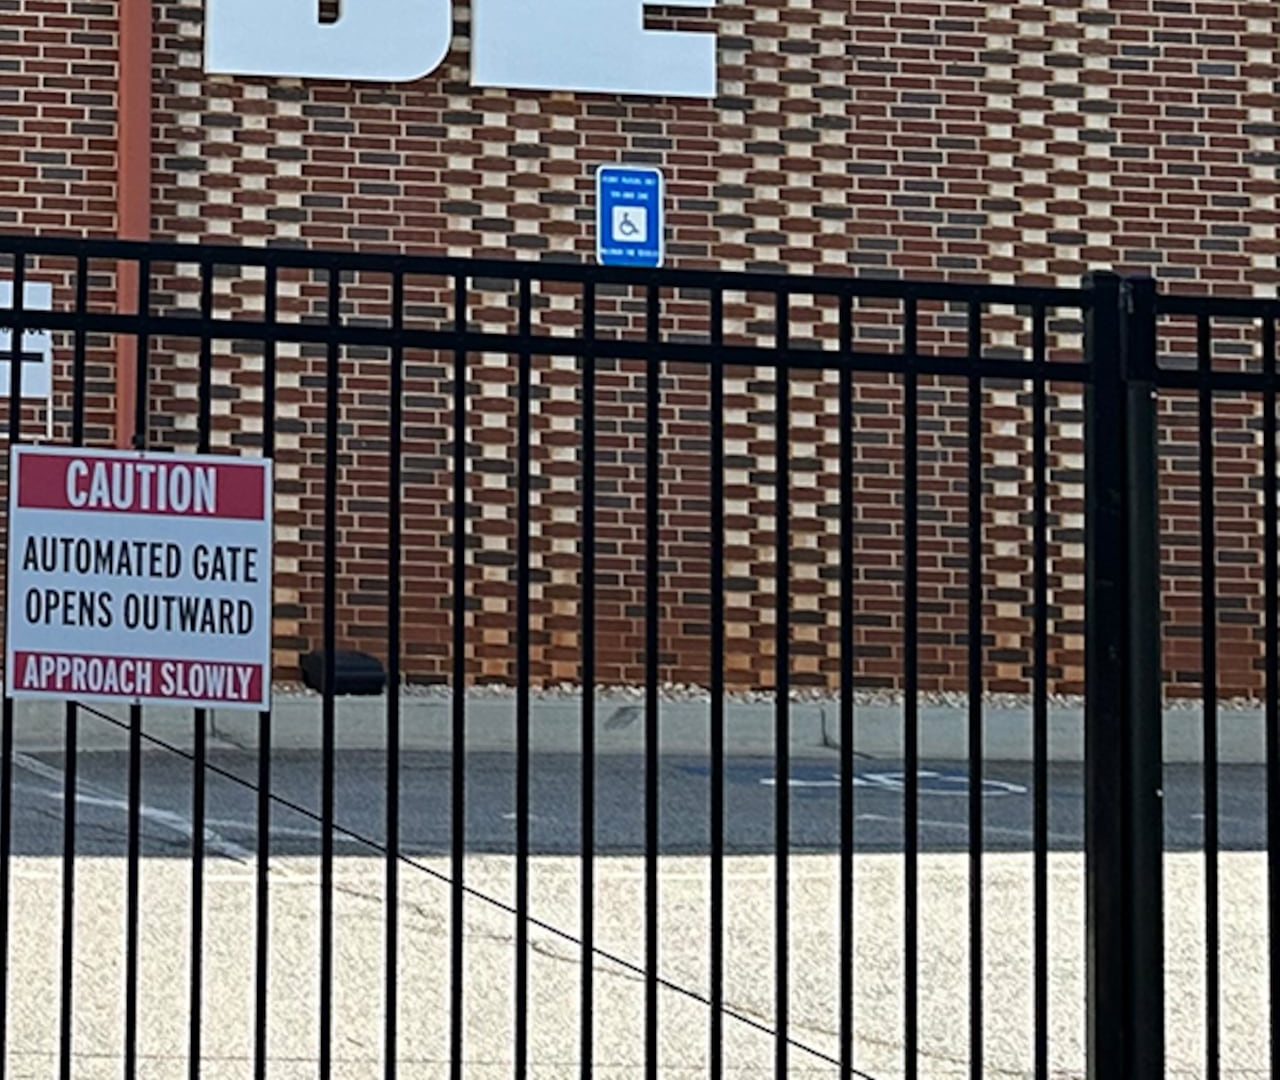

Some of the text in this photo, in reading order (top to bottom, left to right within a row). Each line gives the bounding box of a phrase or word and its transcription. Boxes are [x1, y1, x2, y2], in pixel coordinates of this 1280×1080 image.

[66, 459, 217, 513] CAUTION
[23, 536, 258, 583] AUTOMATED GATE
[25, 588, 253, 635] OPENS OUTWARD
[23, 654, 254, 700] APPROACH SLOWLY
